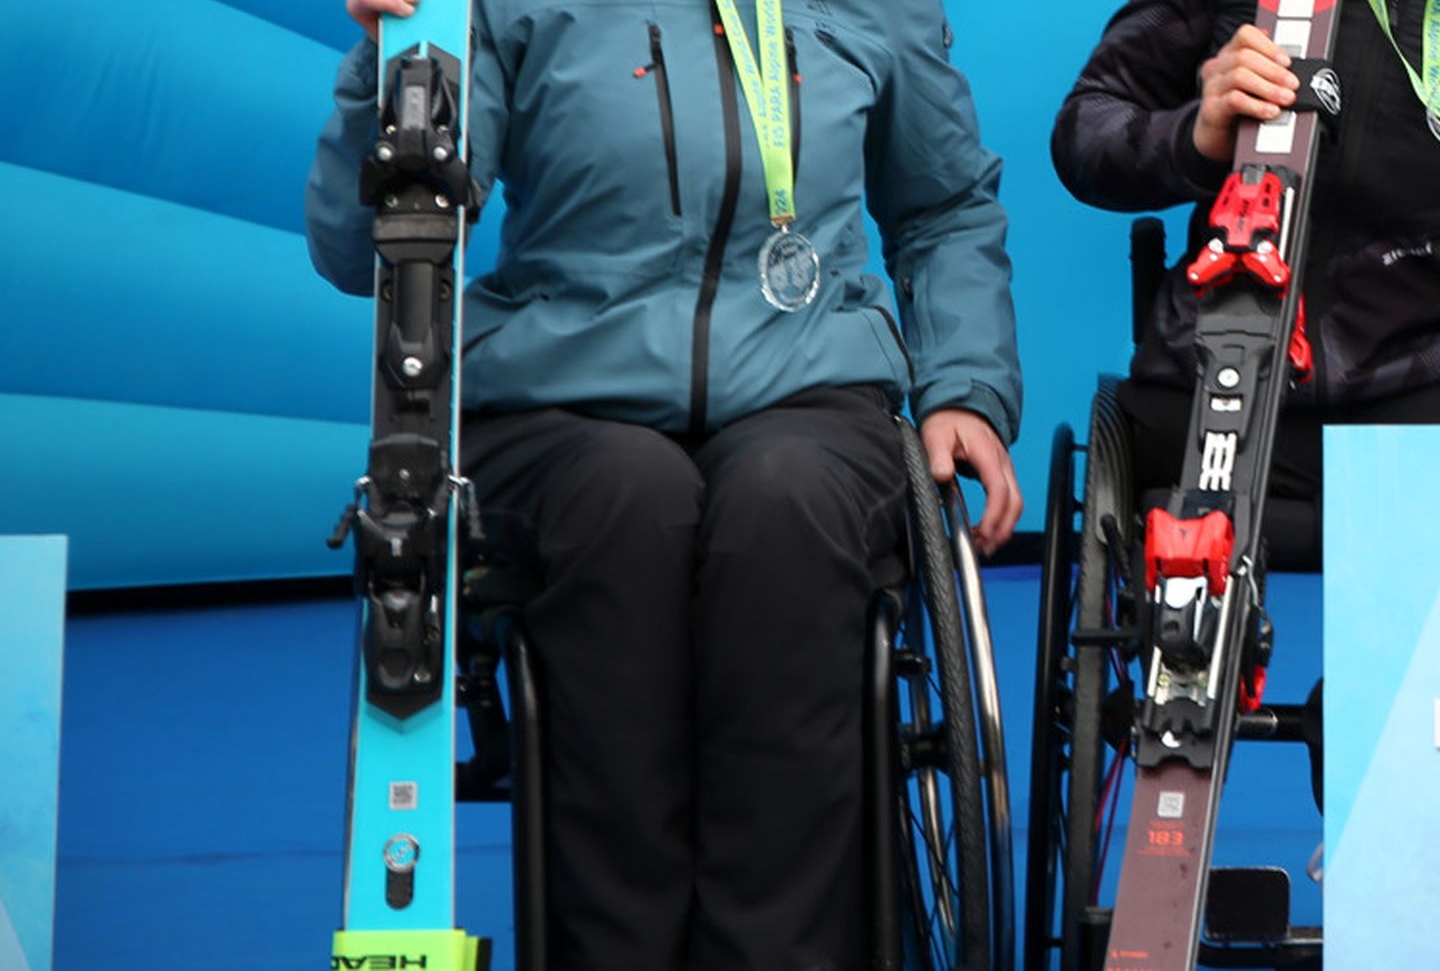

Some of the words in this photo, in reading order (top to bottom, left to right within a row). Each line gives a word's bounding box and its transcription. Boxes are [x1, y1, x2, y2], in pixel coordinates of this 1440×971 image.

[762, 0, 777, 37] World
[766, 41, 782, 82] Alpine
[769, 85, 784, 122] PARA
[1148, 830, 1184, 846] 183
